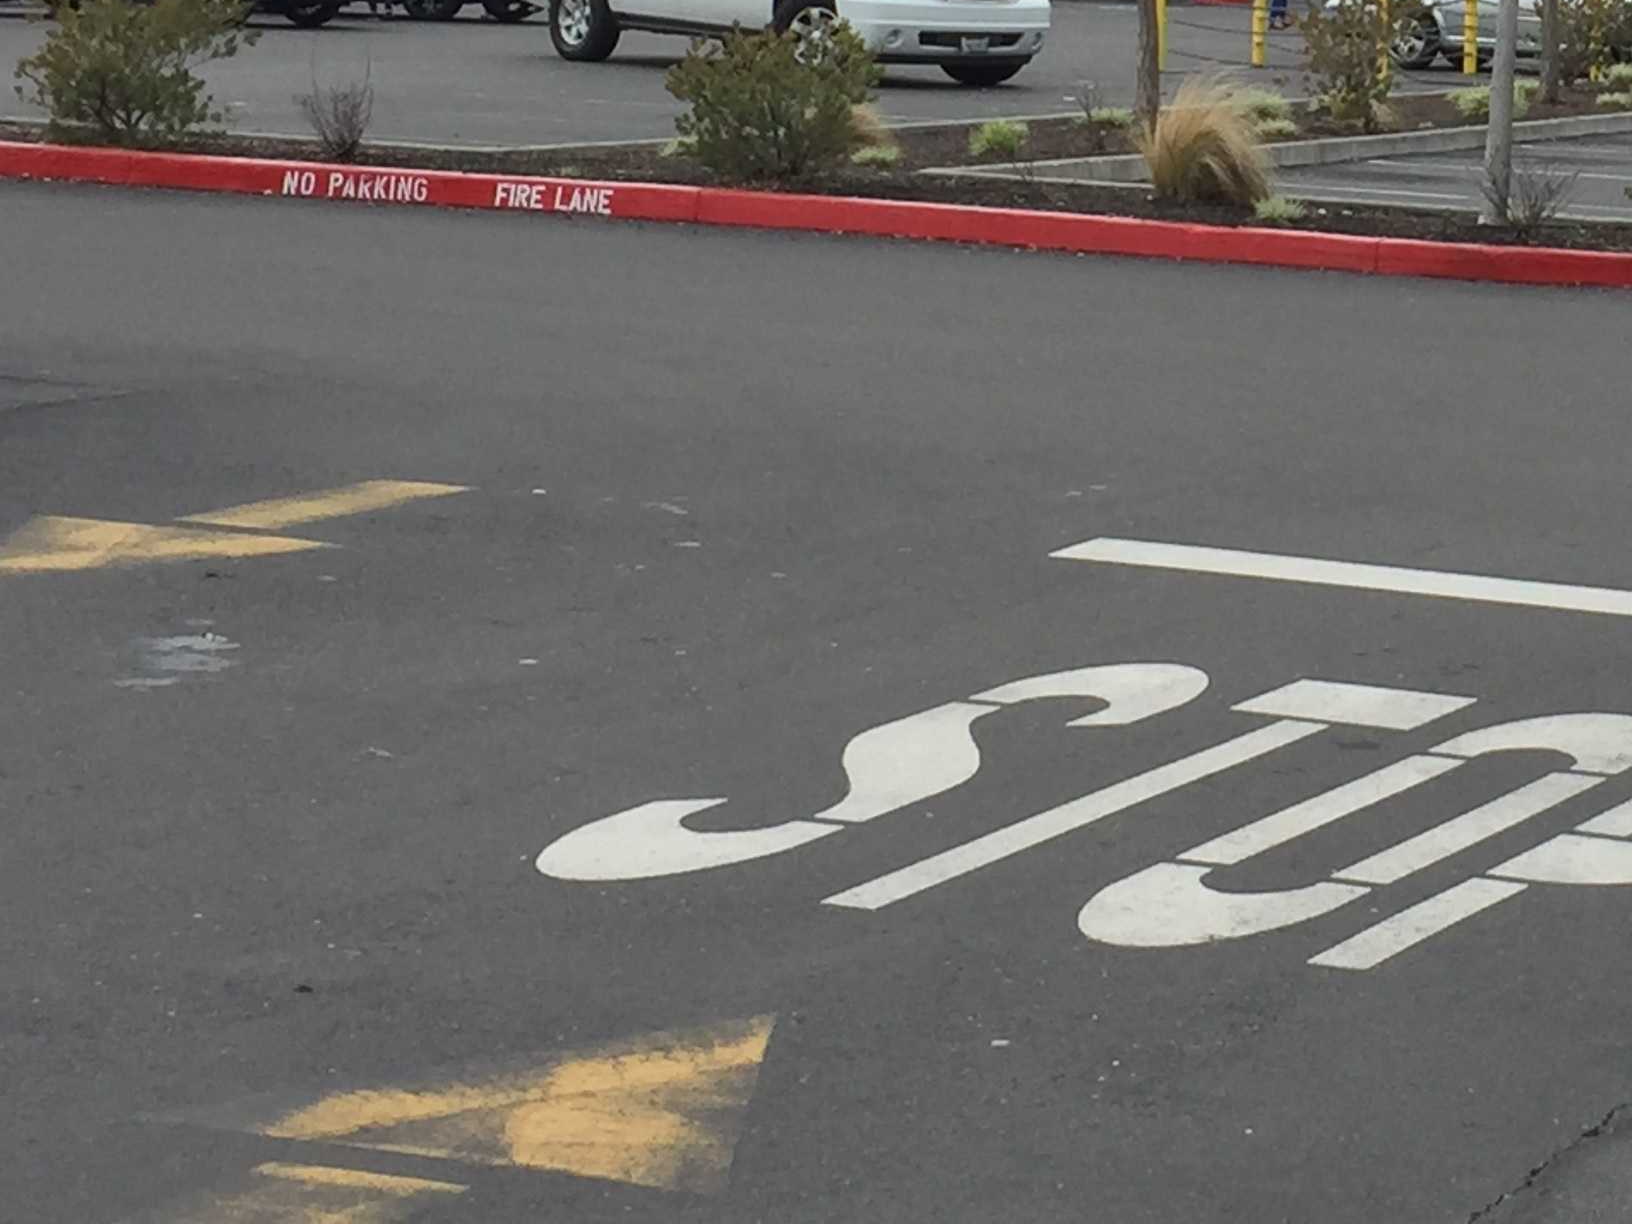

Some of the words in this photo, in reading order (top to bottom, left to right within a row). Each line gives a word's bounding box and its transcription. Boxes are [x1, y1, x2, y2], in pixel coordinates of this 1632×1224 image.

[282, 171, 316, 196] NO
[327, 173, 428, 202] PARKING
[494, 183, 546, 210] FIRE
[553, 188, 615, 214] LANE
